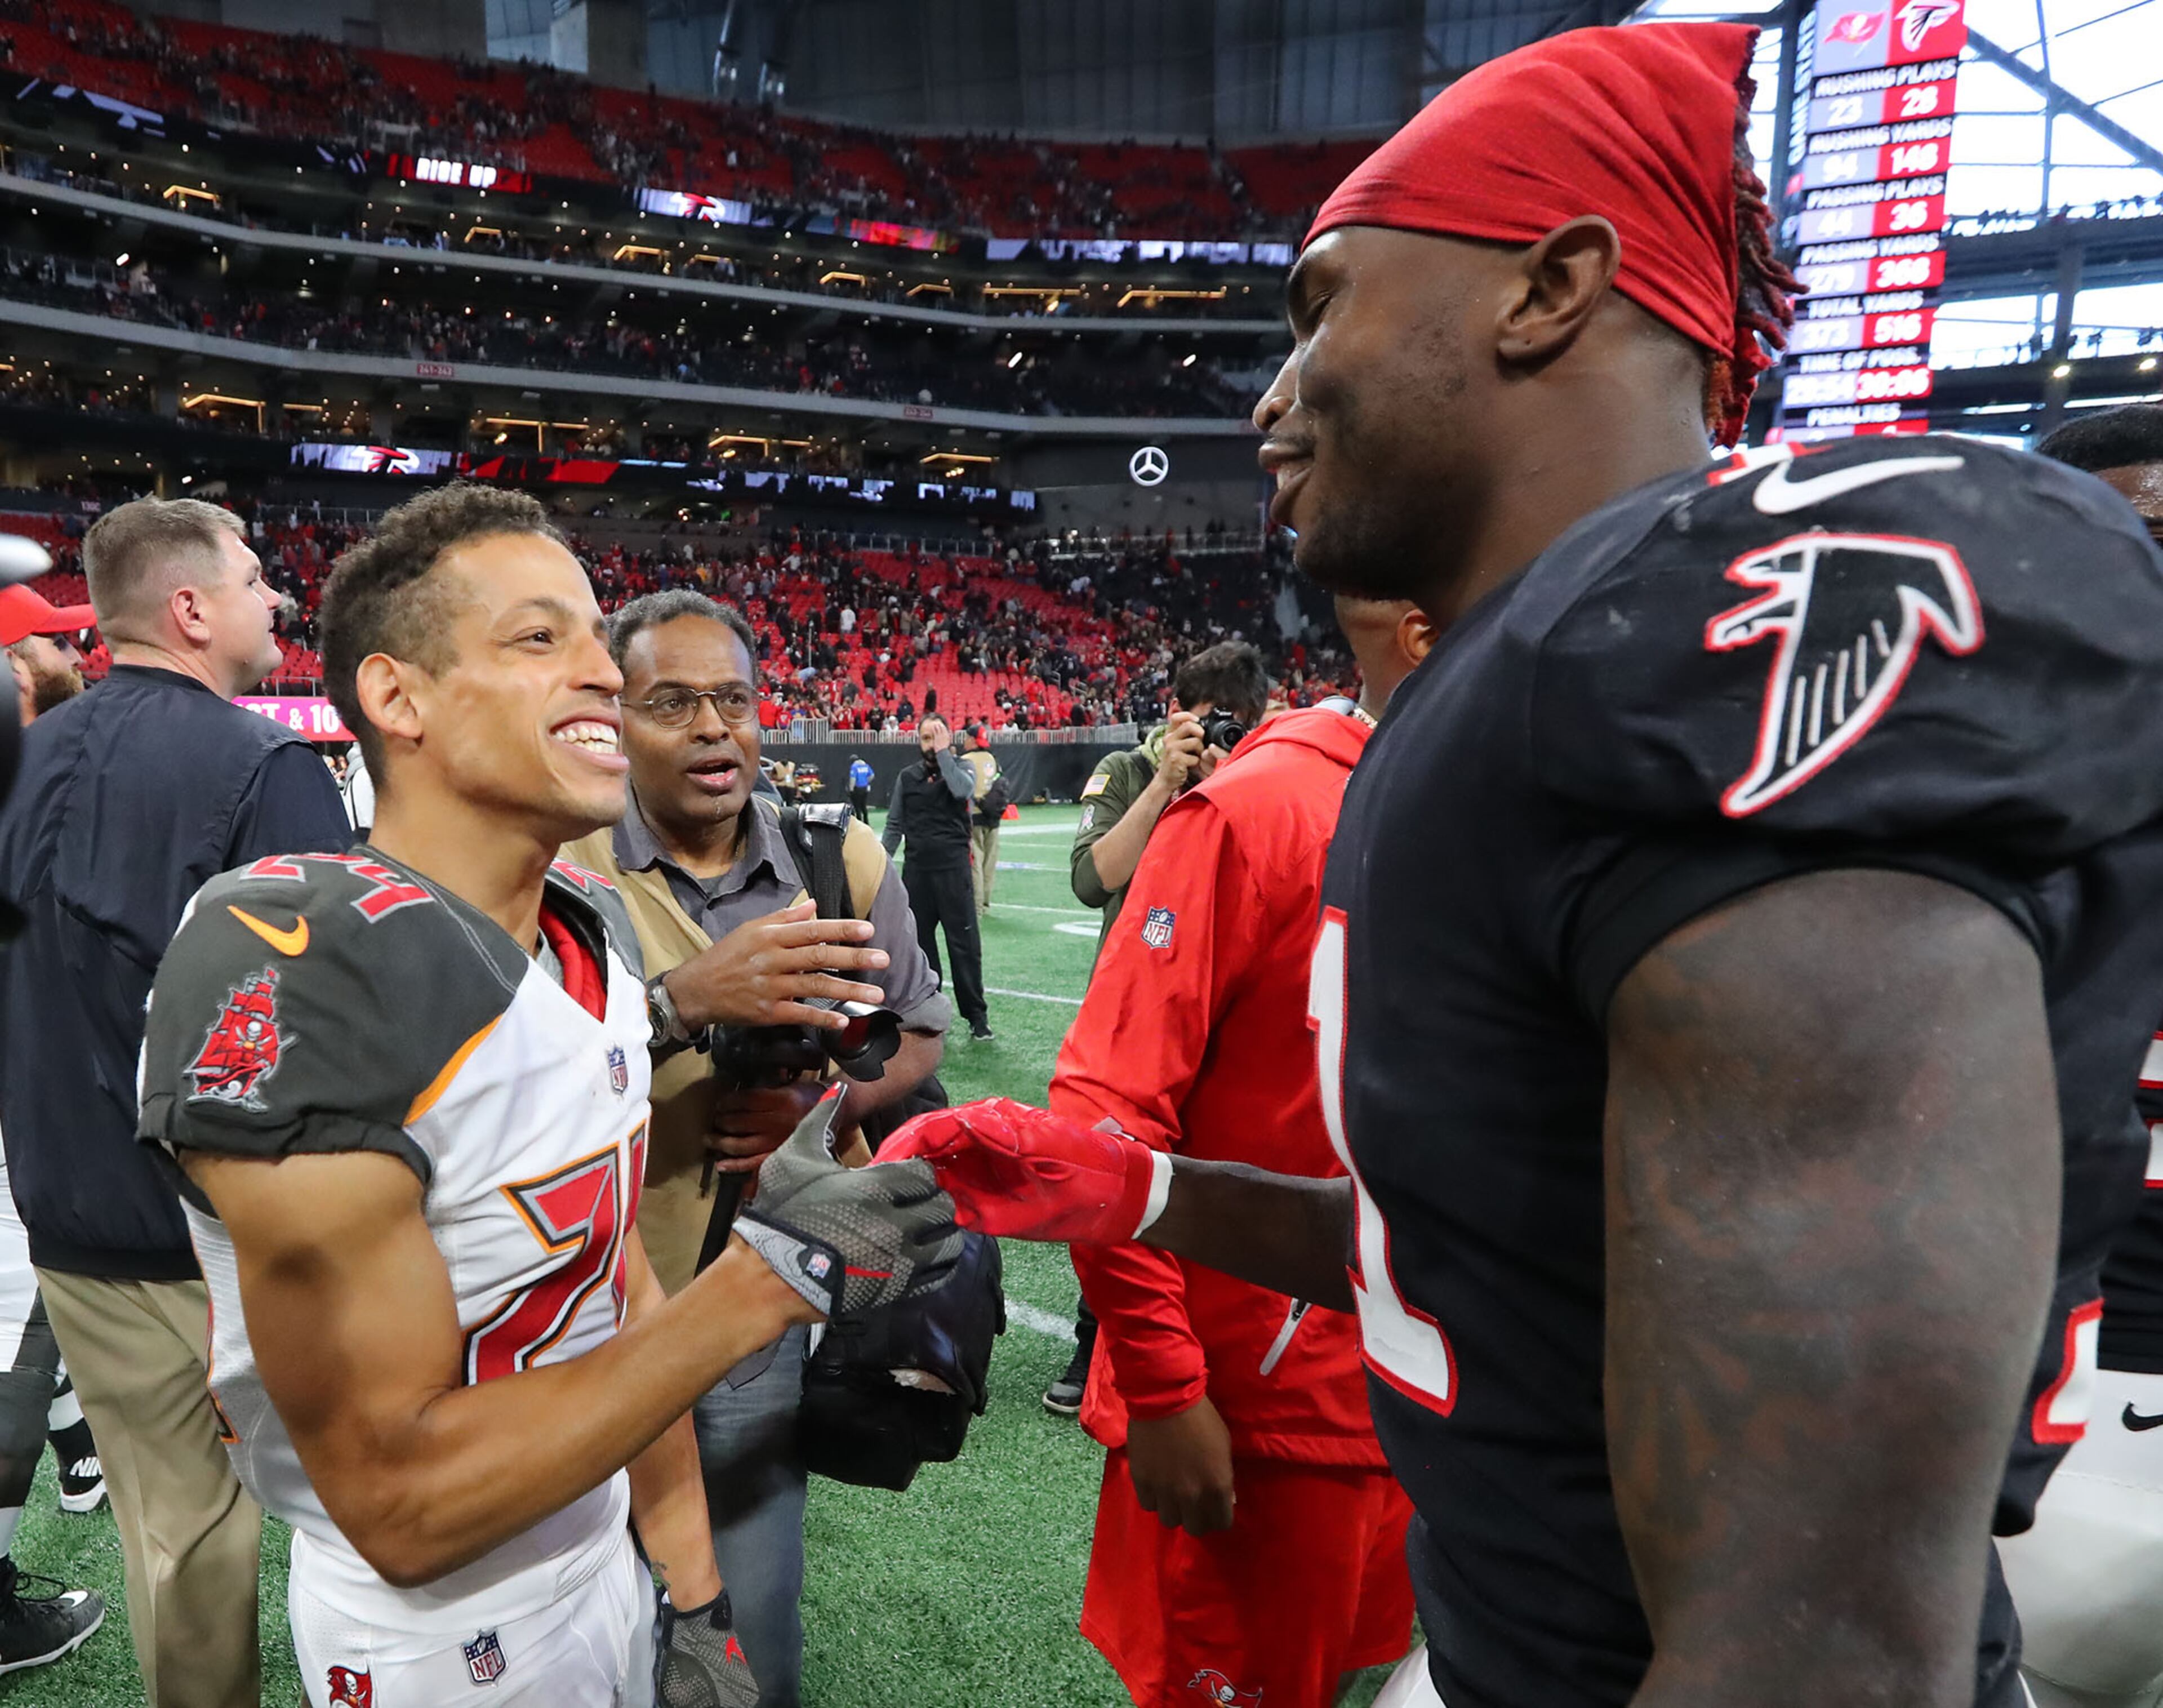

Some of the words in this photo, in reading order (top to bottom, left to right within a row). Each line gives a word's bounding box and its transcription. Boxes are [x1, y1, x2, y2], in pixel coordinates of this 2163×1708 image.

[1793, 10, 1817, 94] STATS
[1815, 68, 1895, 97] RUSHING
[1896, 59, 1957, 86] PLAYS
[1827, 96, 1863, 126] 23
[1787, 89, 1810, 166] GAME
[1809, 126, 1890, 155] RUSHING
[1891, 118, 1952, 143] YARDS
[469, 164, 497, 188] UP
[1806, 183, 1884, 210] PASSING
[1886, 176, 1944, 199] PLAYS
[1800, 241, 1878, 265] PASSING
[1879, 233, 1939, 256] YARDS
[1808, 298, 1863, 319] TOTAL
[1864, 292, 1922, 313] YARDS
[1875, 314, 1921, 344] 516
[1807, 403, 1901, 426] PENALTIES
[289, 708, 304, 731] &
[309, 705, 340, 733] 10
[1145, 923, 1169, 944] NFL
[472, 1651, 502, 1679] NFL
